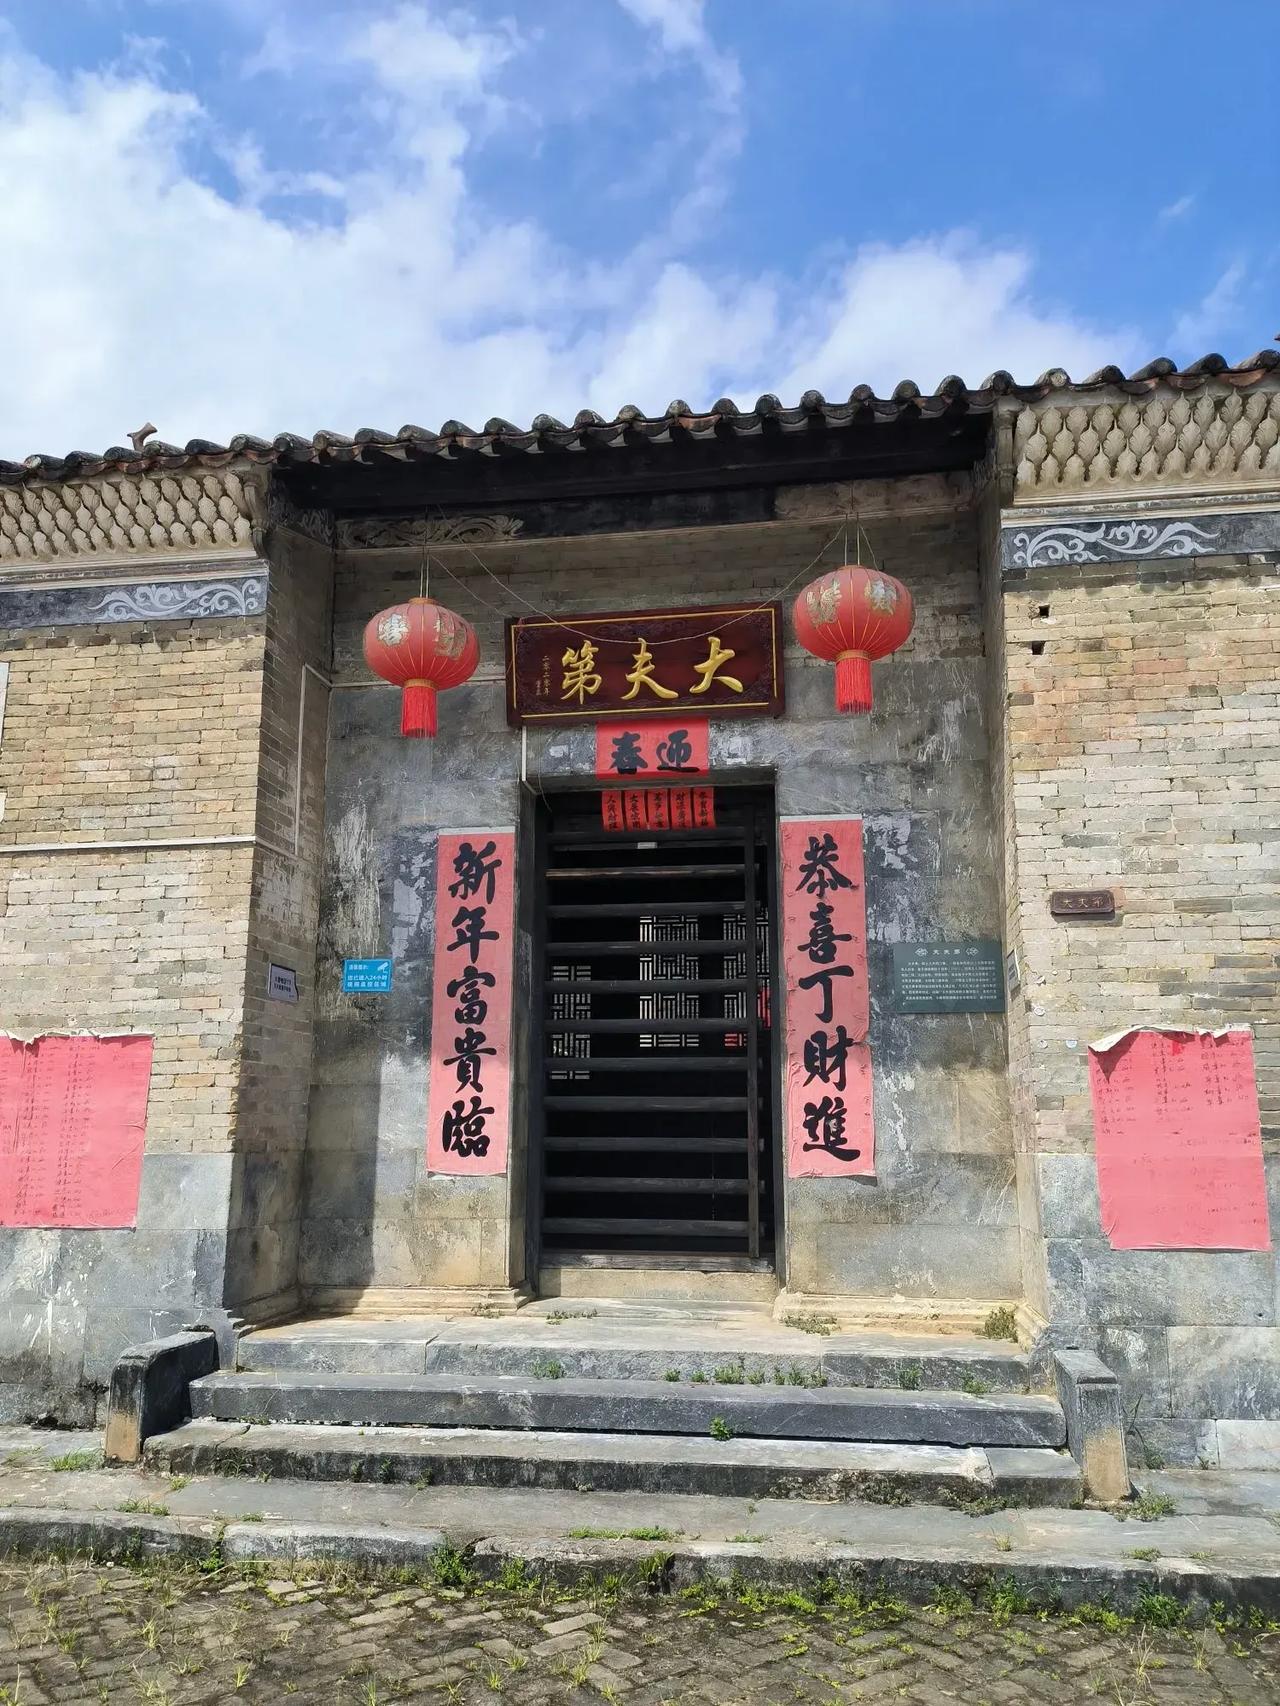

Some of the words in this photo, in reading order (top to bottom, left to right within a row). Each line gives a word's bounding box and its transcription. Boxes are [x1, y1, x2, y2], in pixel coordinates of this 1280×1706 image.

[560, 636, 744, 705] 大夫第
[609, 728, 700, 775] 迎春
[442, 840, 503, 1158] 新年富貴臨
[795, 833, 861, 1162] 恭喜丁財進
